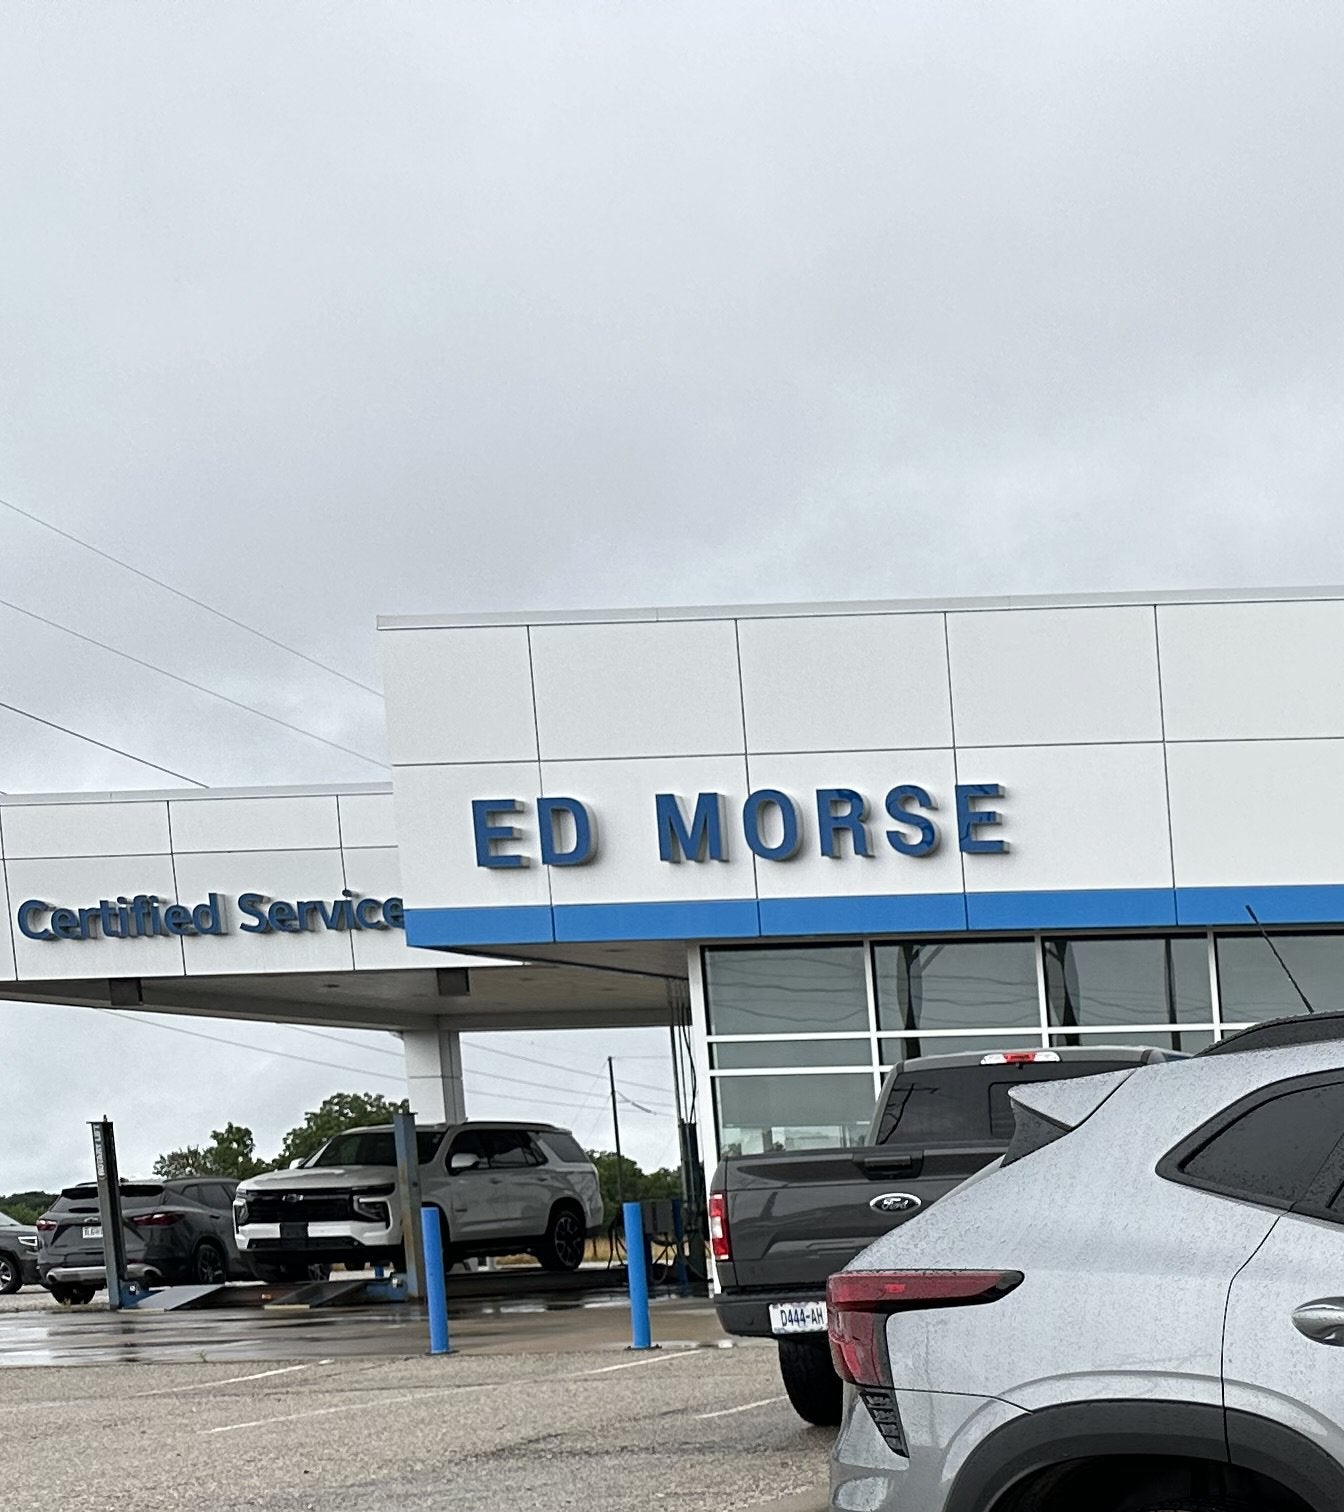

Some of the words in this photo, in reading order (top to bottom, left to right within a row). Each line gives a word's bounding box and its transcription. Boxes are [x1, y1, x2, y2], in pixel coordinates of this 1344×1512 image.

[471, 795, 599, 869] ED
[654, 782, 1011, 864] MORSE
[17, 892, 228, 940] Certified
[237, 888, 405, 934] Service
[93, 1124, 102, 1141] LIFT
